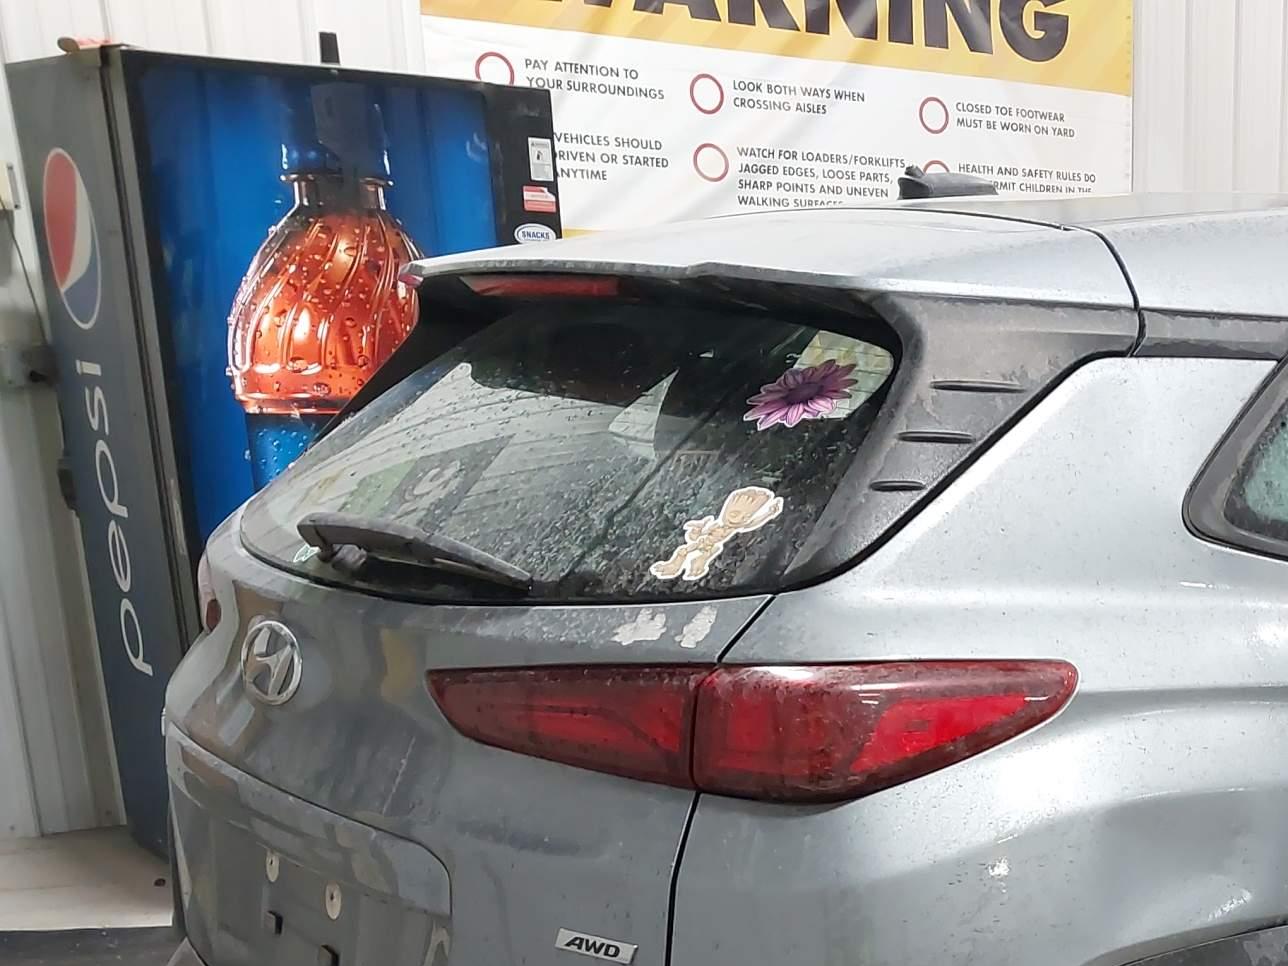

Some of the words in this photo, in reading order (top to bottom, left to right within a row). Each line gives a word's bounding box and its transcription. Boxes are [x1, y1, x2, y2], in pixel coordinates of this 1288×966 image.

[524, 58, 549, 71] PAY
[554, 61, 620, 78] ATTENTION
[623, 68, 639, 80] TO
[526, 76, 563, 90] YOUR
[566, 80, 665, 100] SURROUNDINGS
[733, 79, 763, 93] LOOK
[766, 83, 797, 96] BOTH
[800, 86, 831, 99] WAYS
[834, 89, 865, 102] WHEN
[733, 97, 791, 112] CROSSING
[795, 103, 827, 115] AISLES
[955, 102, 992, 114] CLOSED
[995, 105, 1013, 117] TOE
[1016, 108, 1065, 122] FOOTWEAR
[956, 117, 983, 129] MUST
[986, 120, 997, 130] BE
[1000, 121, 1032, 134] WORN
[1034, 125, 1049, 136] ON
[1052, 126, 1075, 138] YARD
[553, 132, 610, 147] VEHICLES
[614, 136, 663, 150] SHOULD
[600, 153, 618, 165] OR
[622, 154, 669, 168] STARTED
[736, 146, 775, 160] WATCH
[778, 149, 798, 161] FOR
[738, 163, 779, 176] JAGGED
[782, 166, 819, 179] EDGES,
[822, 169, 856, 181] LOOSE
[859, 171, 893, 184] PARTS,
[958, 163, 994, 176] HEALTH
[997, 166, 1019, 177] AND
[1021, 168, 1053, 180] SAFETY
[1056, 171, 1082, 182] RULES
[1084, 173, 1096, 184] DO
[737, 179, 773, 191] SHARP
[776, 181, 816, 194] POINTS
[819, 184, 844, 196] AND
[846, 186, 889, 198] UNEVEN
[1019, 182, 1063, 193] CHILDREN
[737, 195, 790, 208] WALKING
[521, 231, 550, 240] SNACKS
[75, 359, 153, 676] pepsi
[564, 936, 621, 958] AWD
